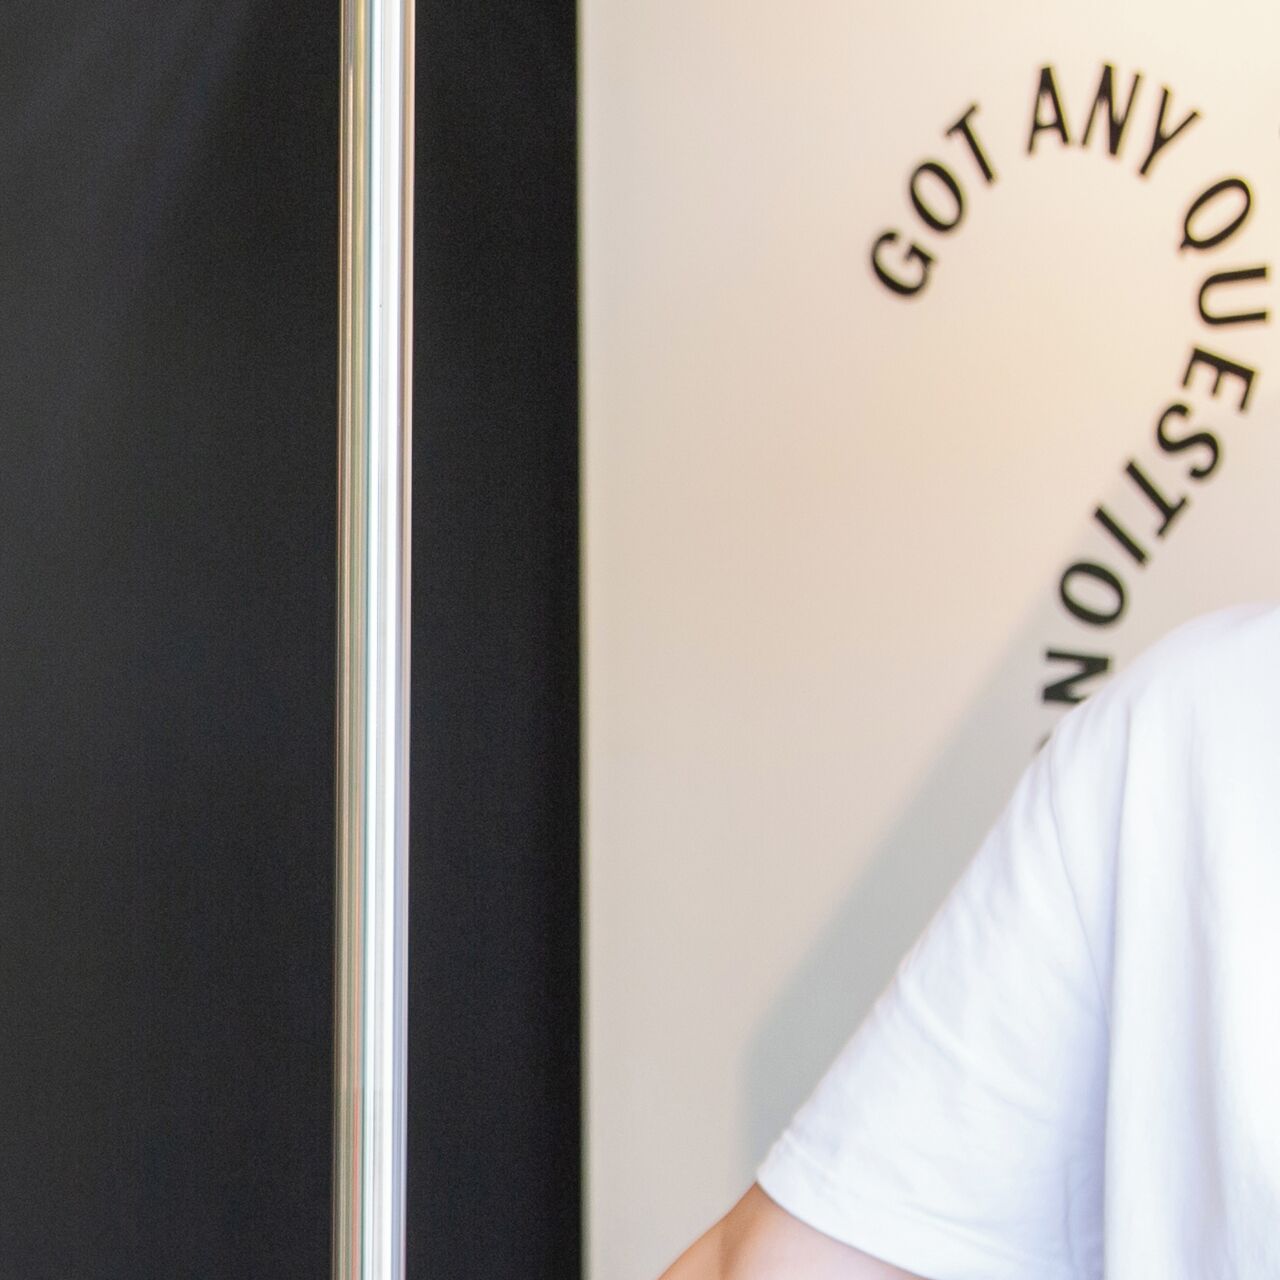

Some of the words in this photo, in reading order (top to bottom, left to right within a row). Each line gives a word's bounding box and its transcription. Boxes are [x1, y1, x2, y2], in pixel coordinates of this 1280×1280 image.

[871, 103, 996, 297] GOT
[1027, 62, 1200, 178] ANY
[1034, 177, 1268, 755] QUESTION
